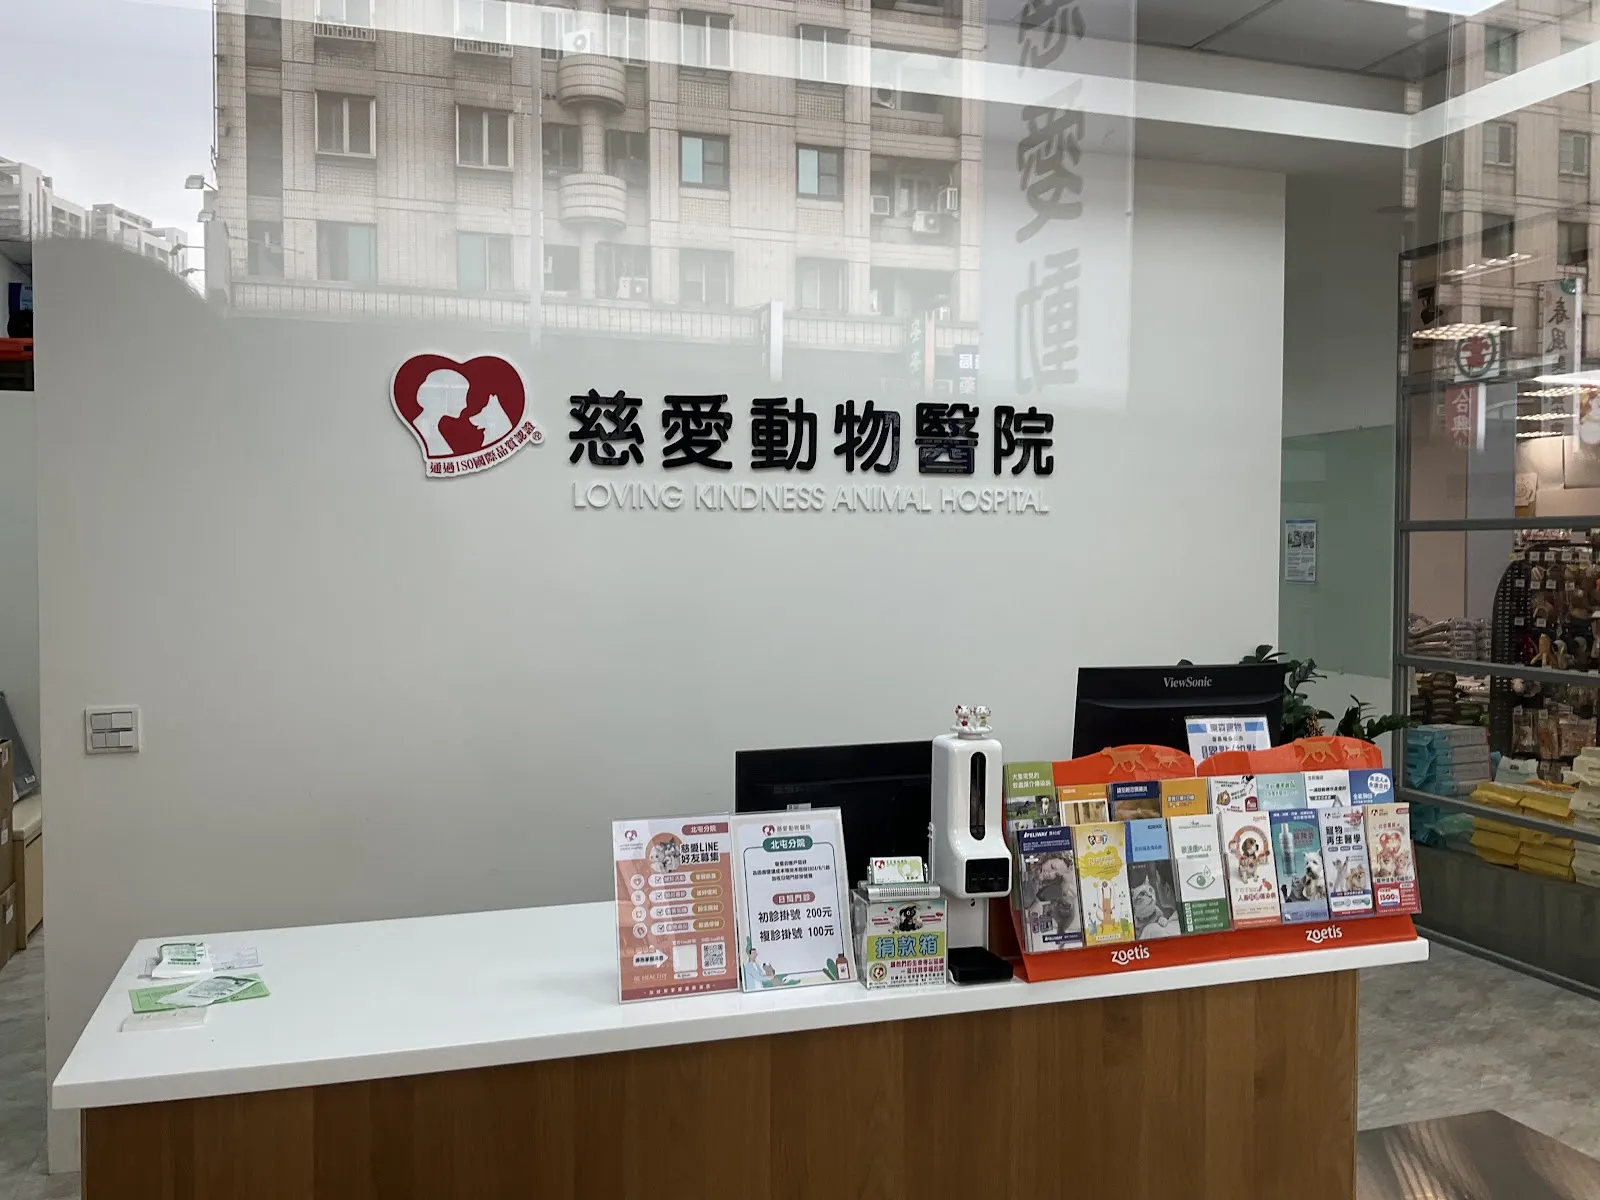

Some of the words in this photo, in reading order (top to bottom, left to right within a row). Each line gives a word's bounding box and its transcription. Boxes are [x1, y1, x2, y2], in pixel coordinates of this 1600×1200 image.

[569, 388, 1054, 476] 慈愛動物醫院
[572, 480, 683, 510] LOVING
[695, 483, 826, 512] KINDNESS
[832, 485, 932, 513] ANIMAL
[940, 486, 1050, 515] HOSPITAL
[1163, 675, 1212, 689] ViewSonic
[770, 838, 806, 850] 北屯分院
[680, 852, 721, 865] 好友募集
[778, 893, 811, 904] 日間門診
[758, 908, 801, 923] 初診掛號
[806, 906, 833, 919] 200元
[759, 927, 803, 942] 複診掛號
[808, 925, 835, 937] 100元
[1305, 925, 1343, 943] zoetis
[875, 933, 939, 960] 捐款箱
[1111, 945, 1150, 965] zoetis
